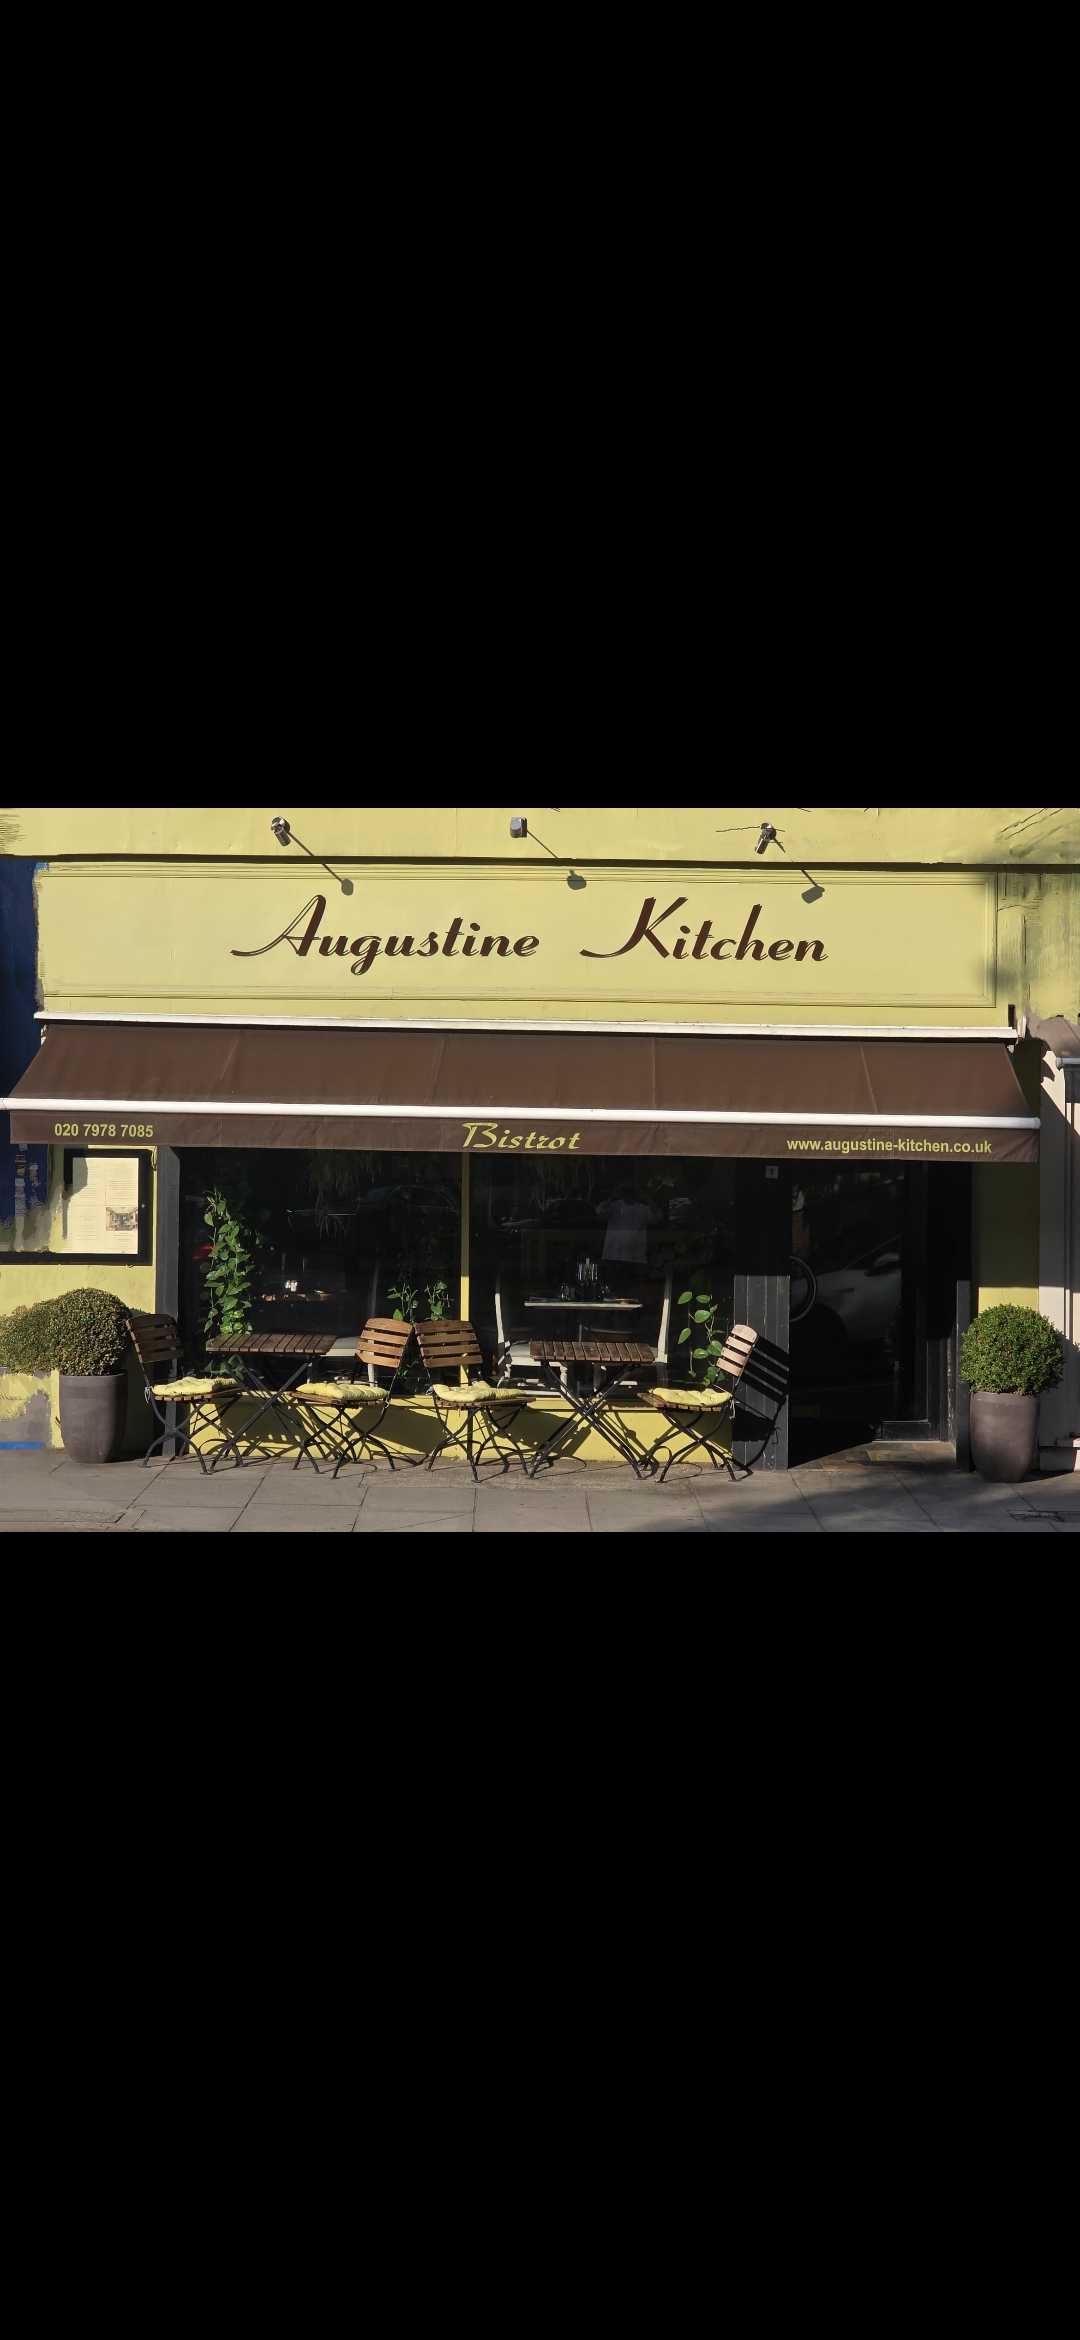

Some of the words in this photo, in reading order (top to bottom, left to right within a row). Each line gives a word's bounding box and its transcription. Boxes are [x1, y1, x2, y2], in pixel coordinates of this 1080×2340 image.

[230, 894, 540, 976] Augustine
[579, 896, 829, 962] Kitchen
[54, 1123, 78, 1136] 020
[83, 1124, 116, 1137] 7978
[120, 1125, 154, 1137] 7085
[462, 1122, 580, 1149] Bistrot
[787, 1138, 992, 1153] www.augustine-kitchen.co.uk
